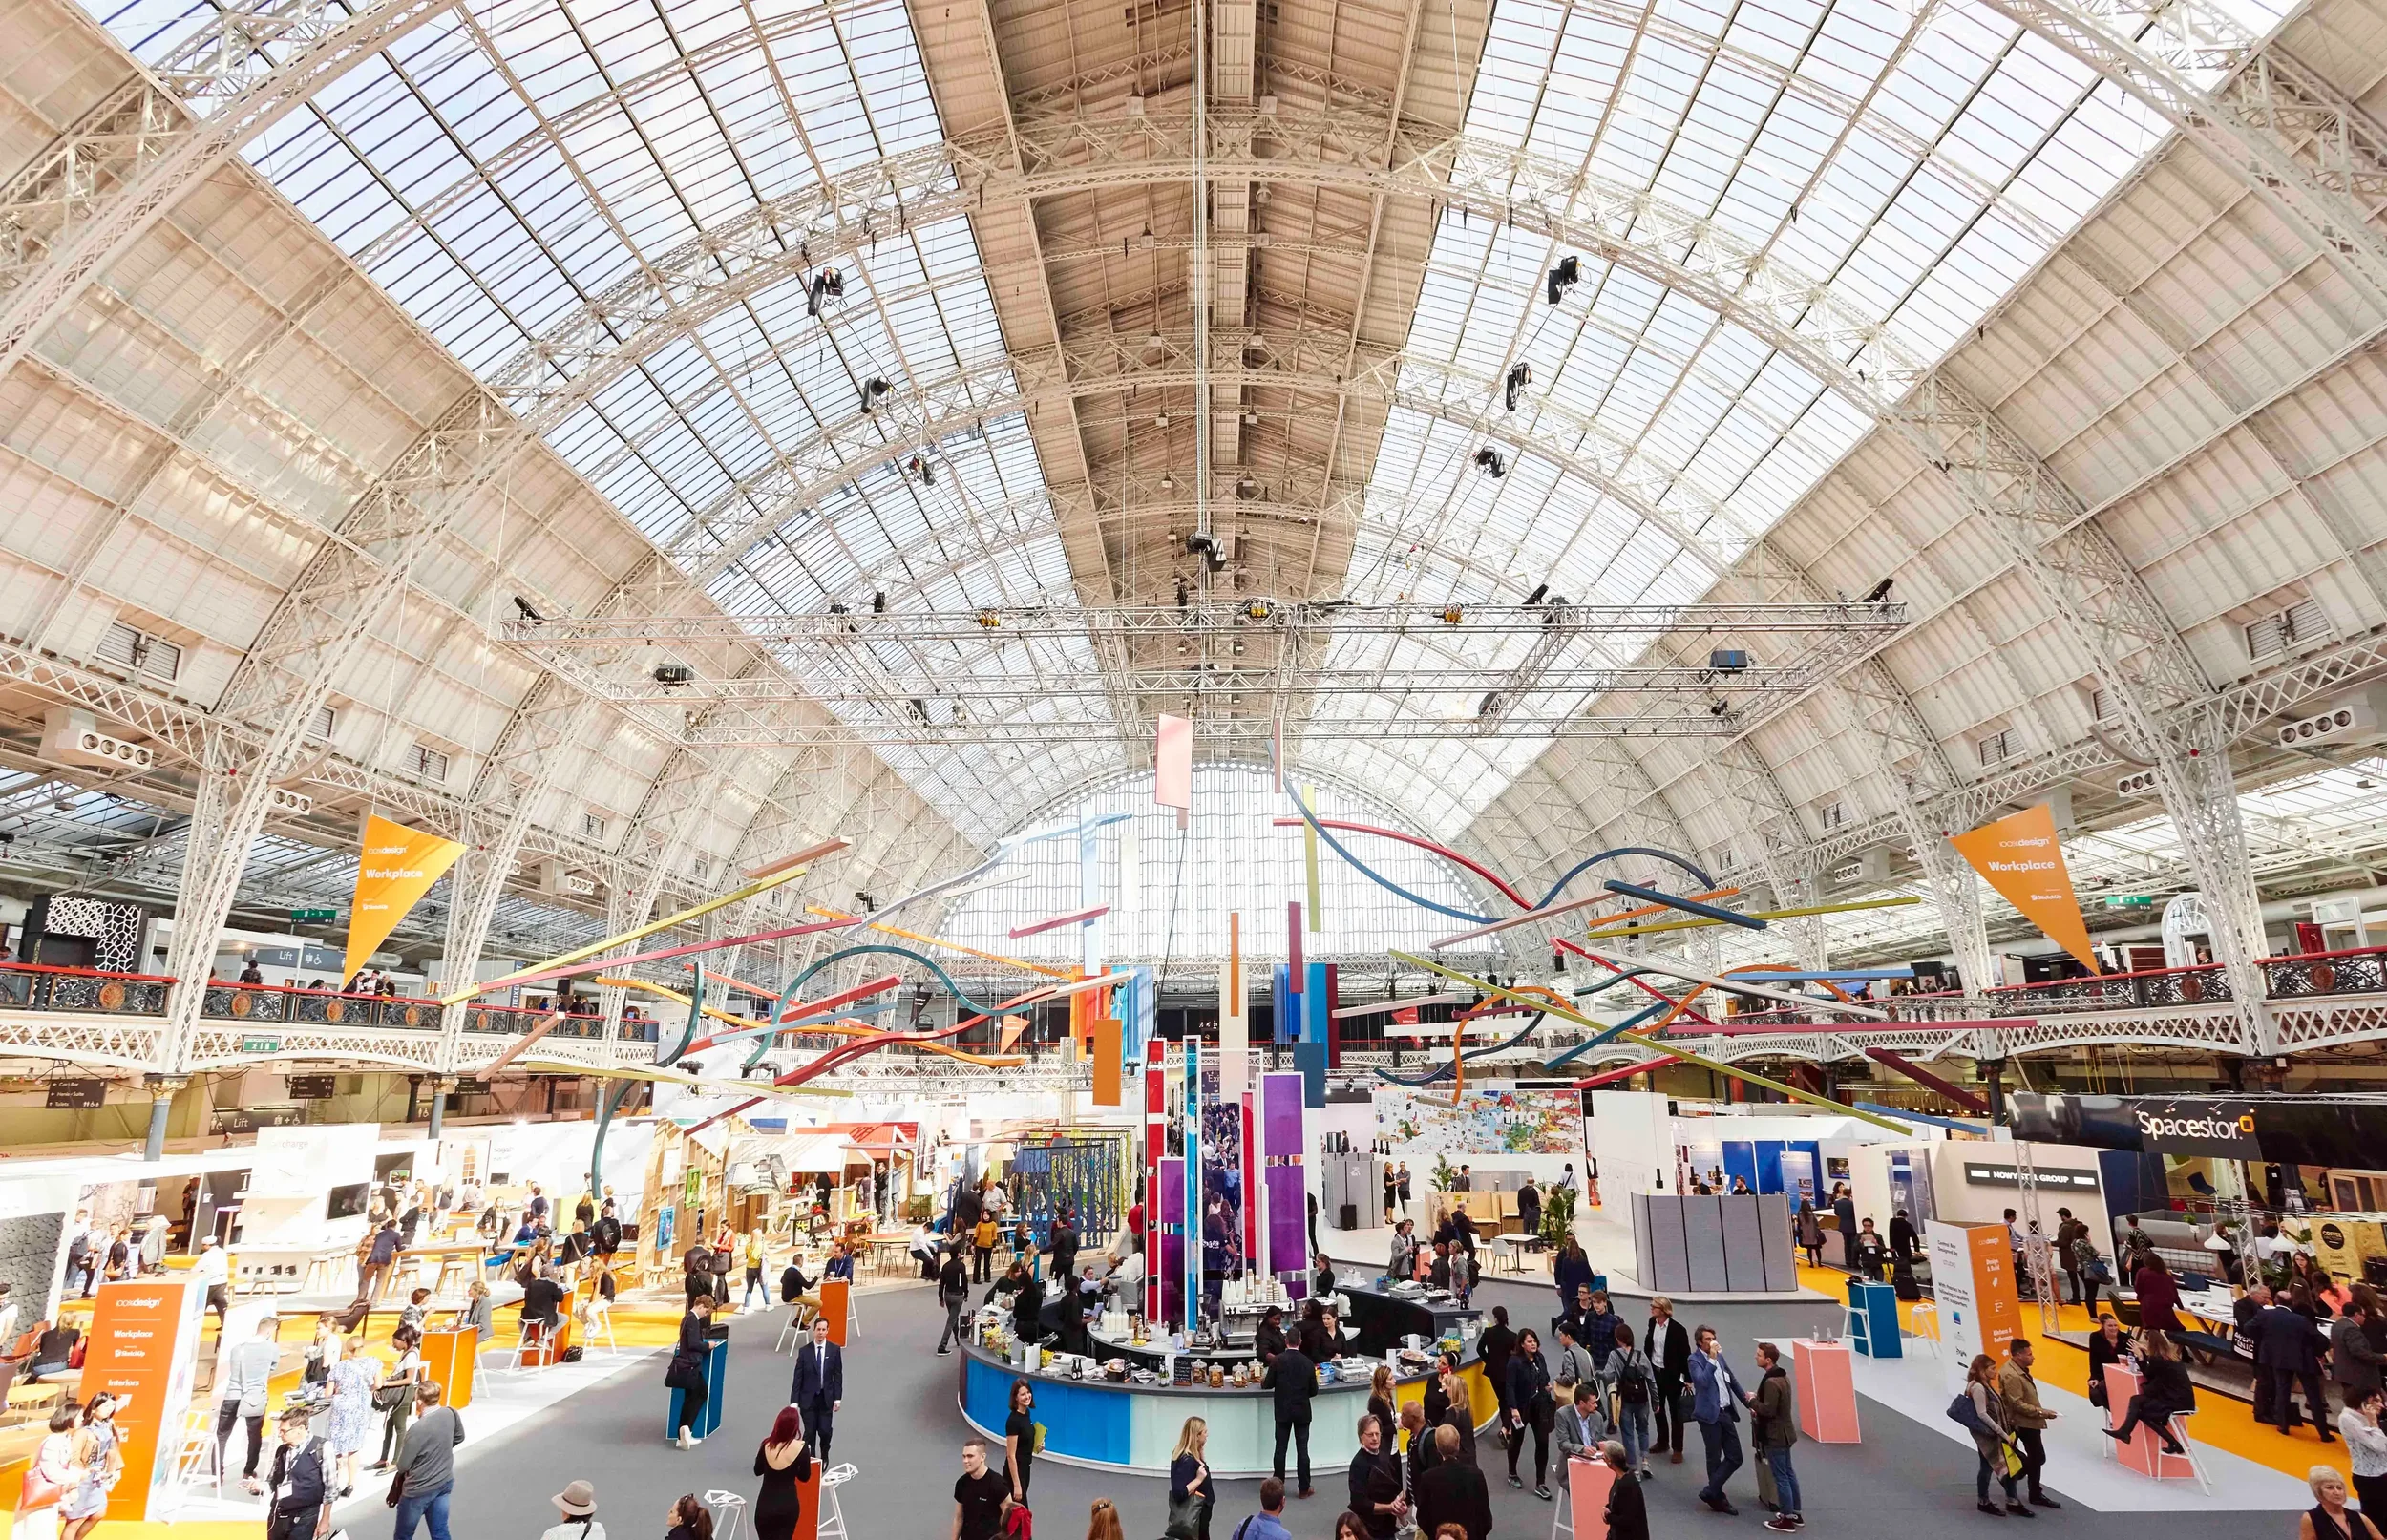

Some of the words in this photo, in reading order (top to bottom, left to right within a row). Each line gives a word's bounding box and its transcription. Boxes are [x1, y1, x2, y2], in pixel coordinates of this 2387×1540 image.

[1988, 860, 2055, 873] Workplace
[366, 868, 424, 880] Workplace
[279, 951, 293, 960] Lift
[234, 1118, 248, 1128] Lift
[1993, 1171, 2018, 1180] NOWY
[2039, 1174, 2069, 1183] GROUP
[114, 1330, 153, 1339] Workplace
